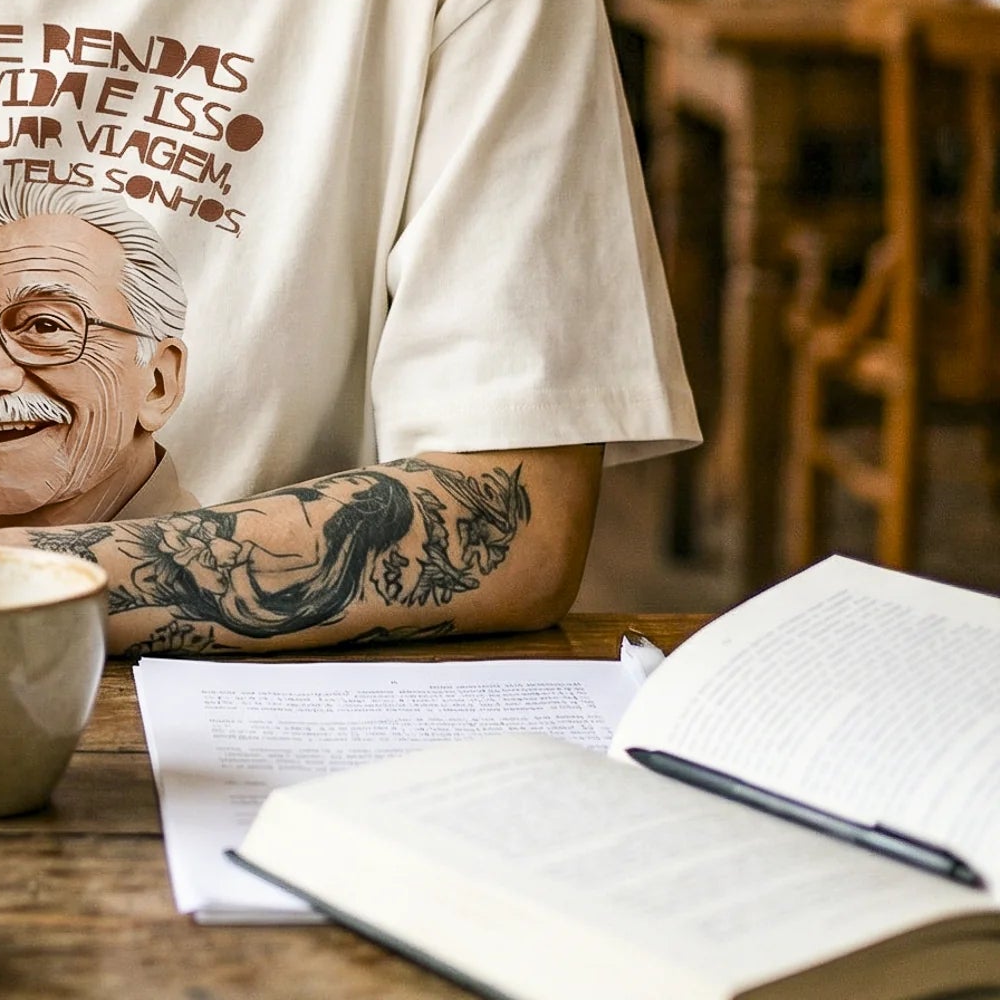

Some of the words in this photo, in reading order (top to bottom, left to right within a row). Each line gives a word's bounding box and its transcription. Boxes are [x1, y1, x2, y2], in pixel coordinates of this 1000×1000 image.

[43, 23, 255, 93] RENDAS
[143, 85, 264, 152] ISSO
[3, 158, 95, 188] TEUS
[77, 121, 232, 195] VIAGEM,
